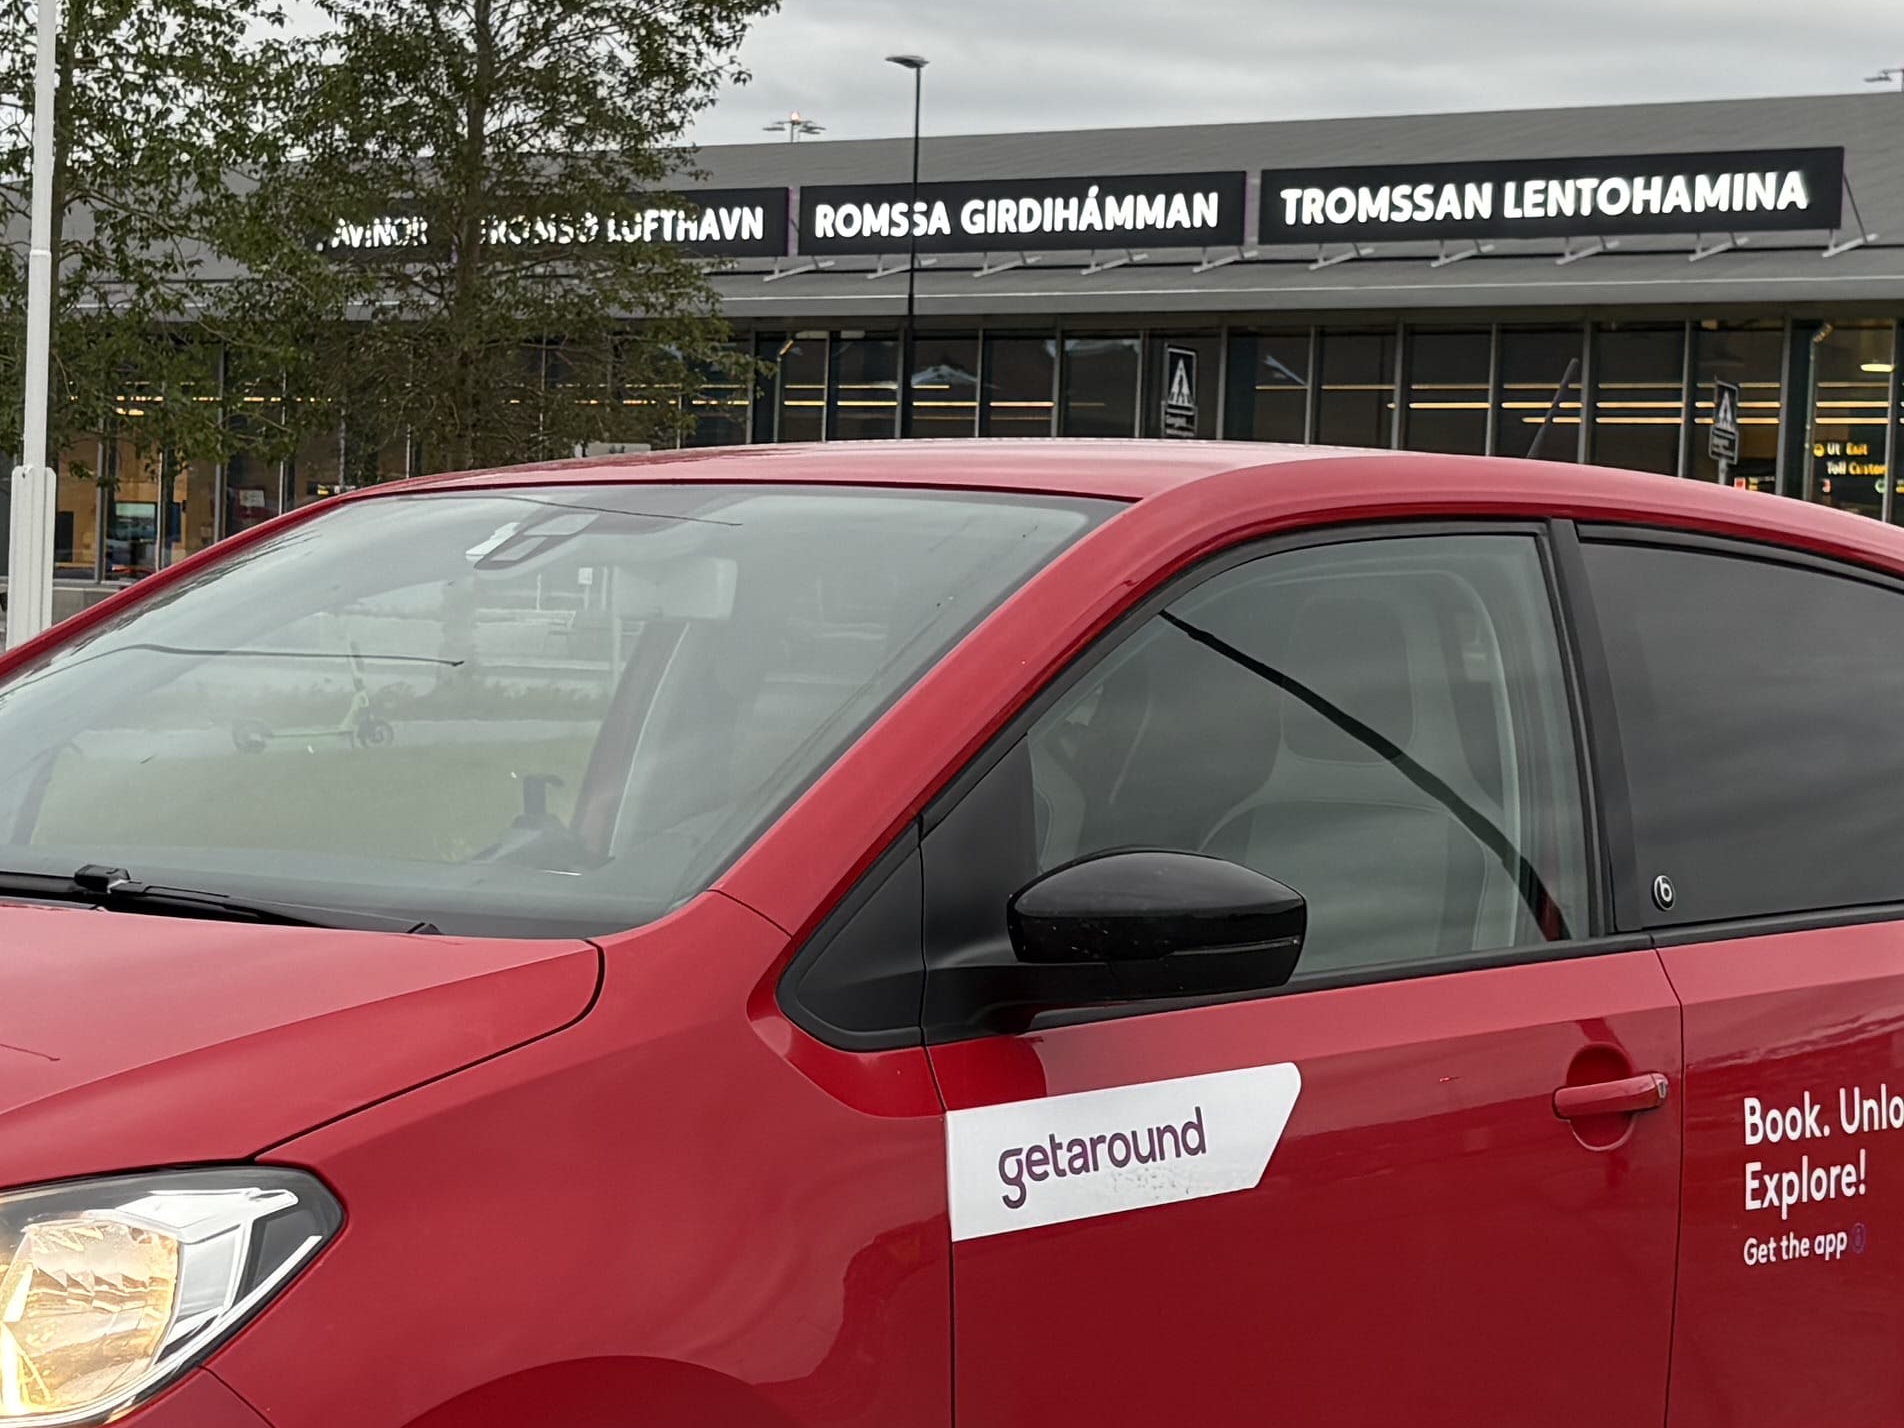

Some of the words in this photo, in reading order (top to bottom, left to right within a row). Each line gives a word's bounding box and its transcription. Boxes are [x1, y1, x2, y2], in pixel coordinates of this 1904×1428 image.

[607, 206, 765, 243] LUFTHAVN
[814, 200, 951, 239] ROMSSA
[960, 185, 1219, 235] GIRDIHÁMMAN
[1280, 182, 1493, 226] TROMSSAN
[1504, 171, 1809, 219] LENTOHAMINA
[1744, 1091, 1830, 1145] Book.
[998, 1106, 1206, 1209] getaround
[1745, 1148, 1866, 1220] Explore!
[1744, 1237, 1776, 1266] Get
[1780, 1232, 1810, 1260] the
[1814, 1231, 1848, 1261] app
